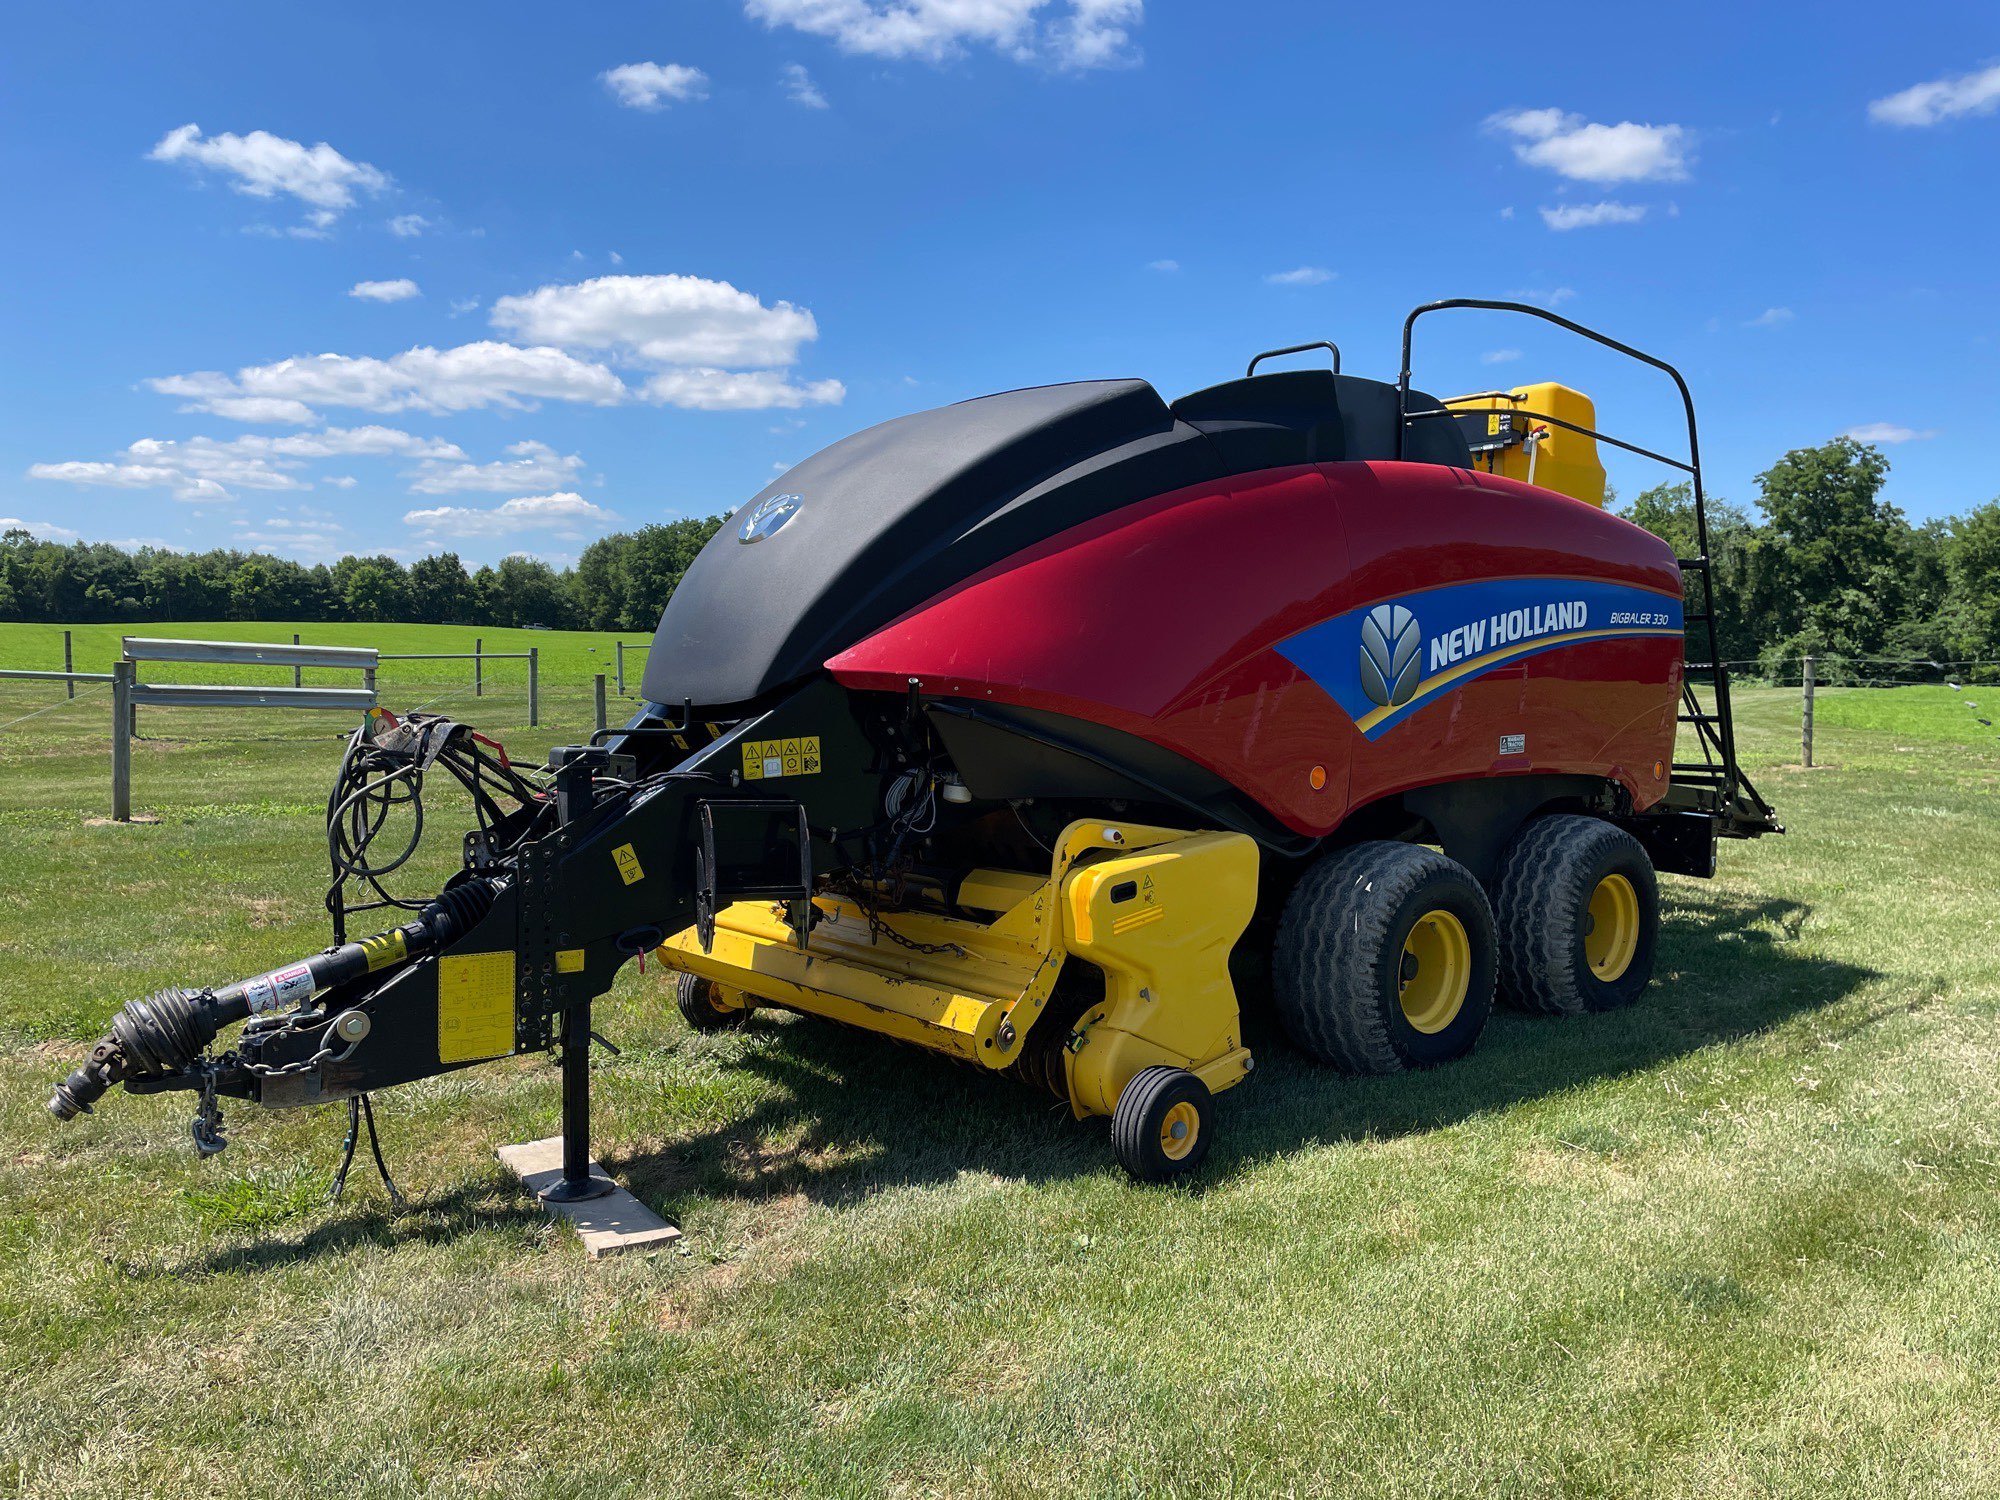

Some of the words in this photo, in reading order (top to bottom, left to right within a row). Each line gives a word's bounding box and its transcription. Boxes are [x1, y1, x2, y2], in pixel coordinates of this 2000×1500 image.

[1430, 619, 1486, 672] NEW
[1490, 600, 1588, 647] HOLLAND
[1610, 612, 1651, 625] BIGBALER
[1652, 614, 1668, 626] 330
